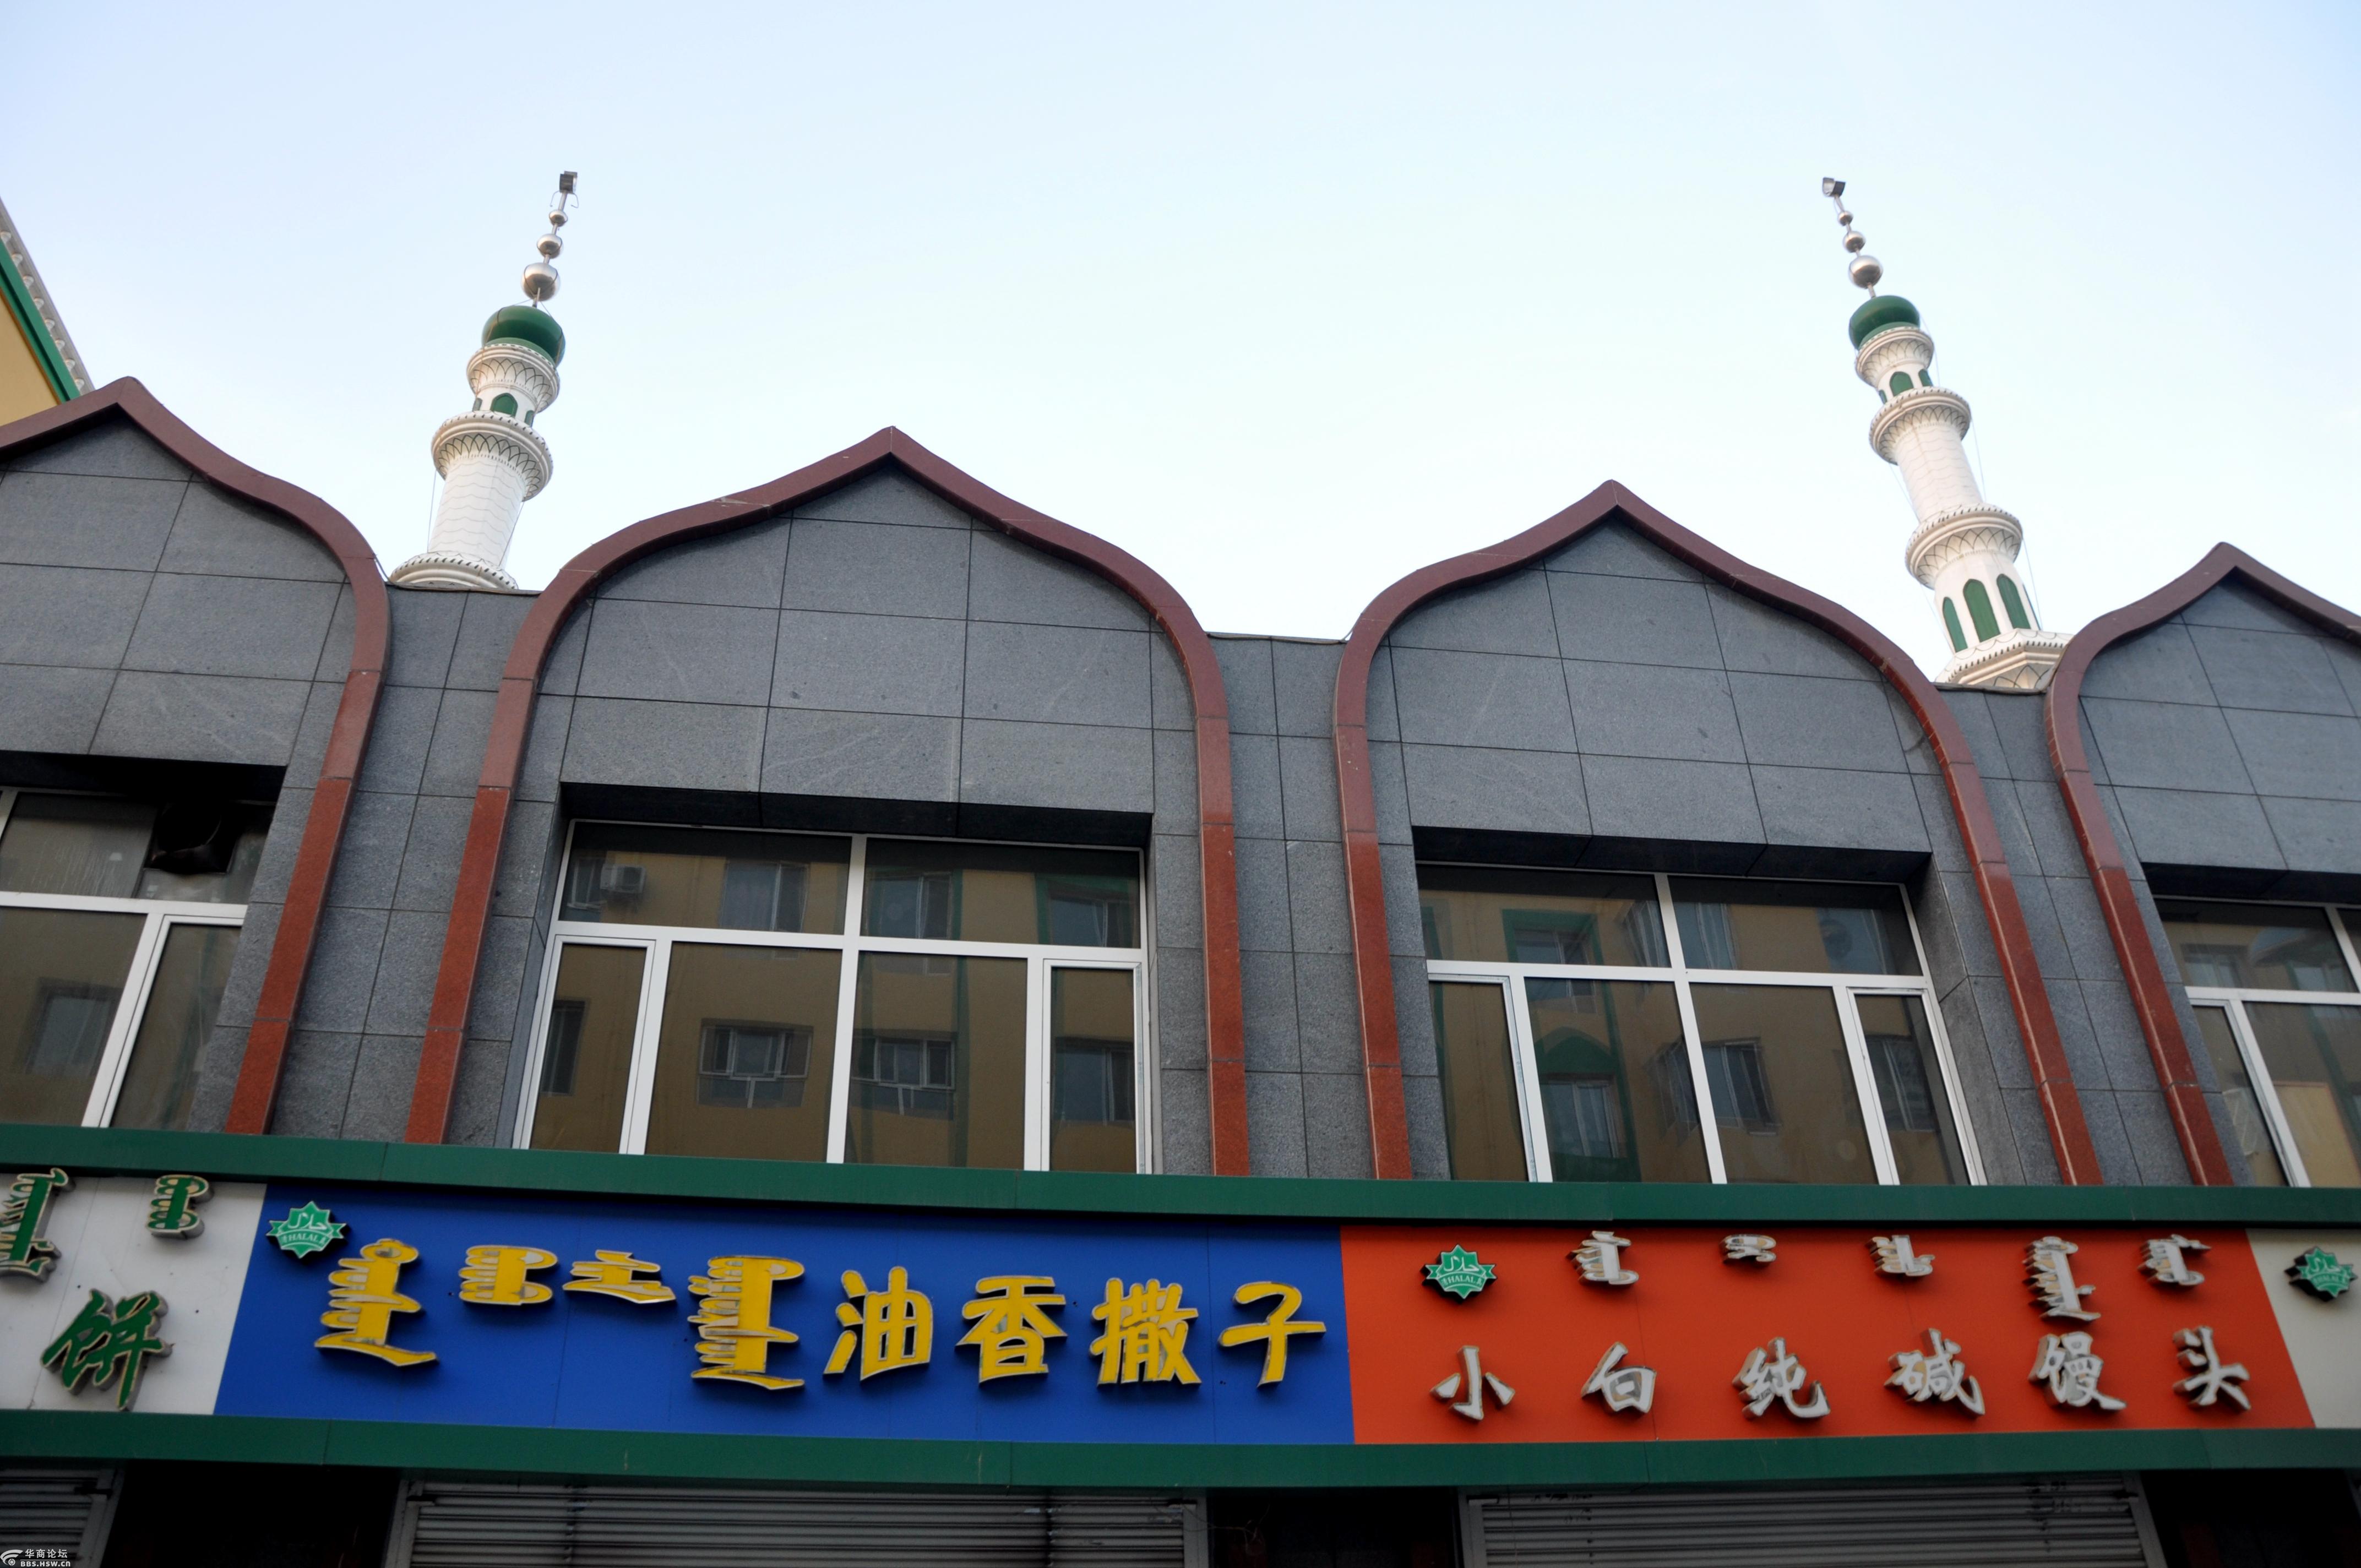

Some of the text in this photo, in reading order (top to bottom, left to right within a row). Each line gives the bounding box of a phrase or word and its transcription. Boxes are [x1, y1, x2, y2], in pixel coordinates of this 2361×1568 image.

[1447, 1275, 1477, 1284] HALAL
[823, 1265, 1327, 1390] 油香撒子
[1431, 1325, 2251, 1420] 小白纯碱馒头
